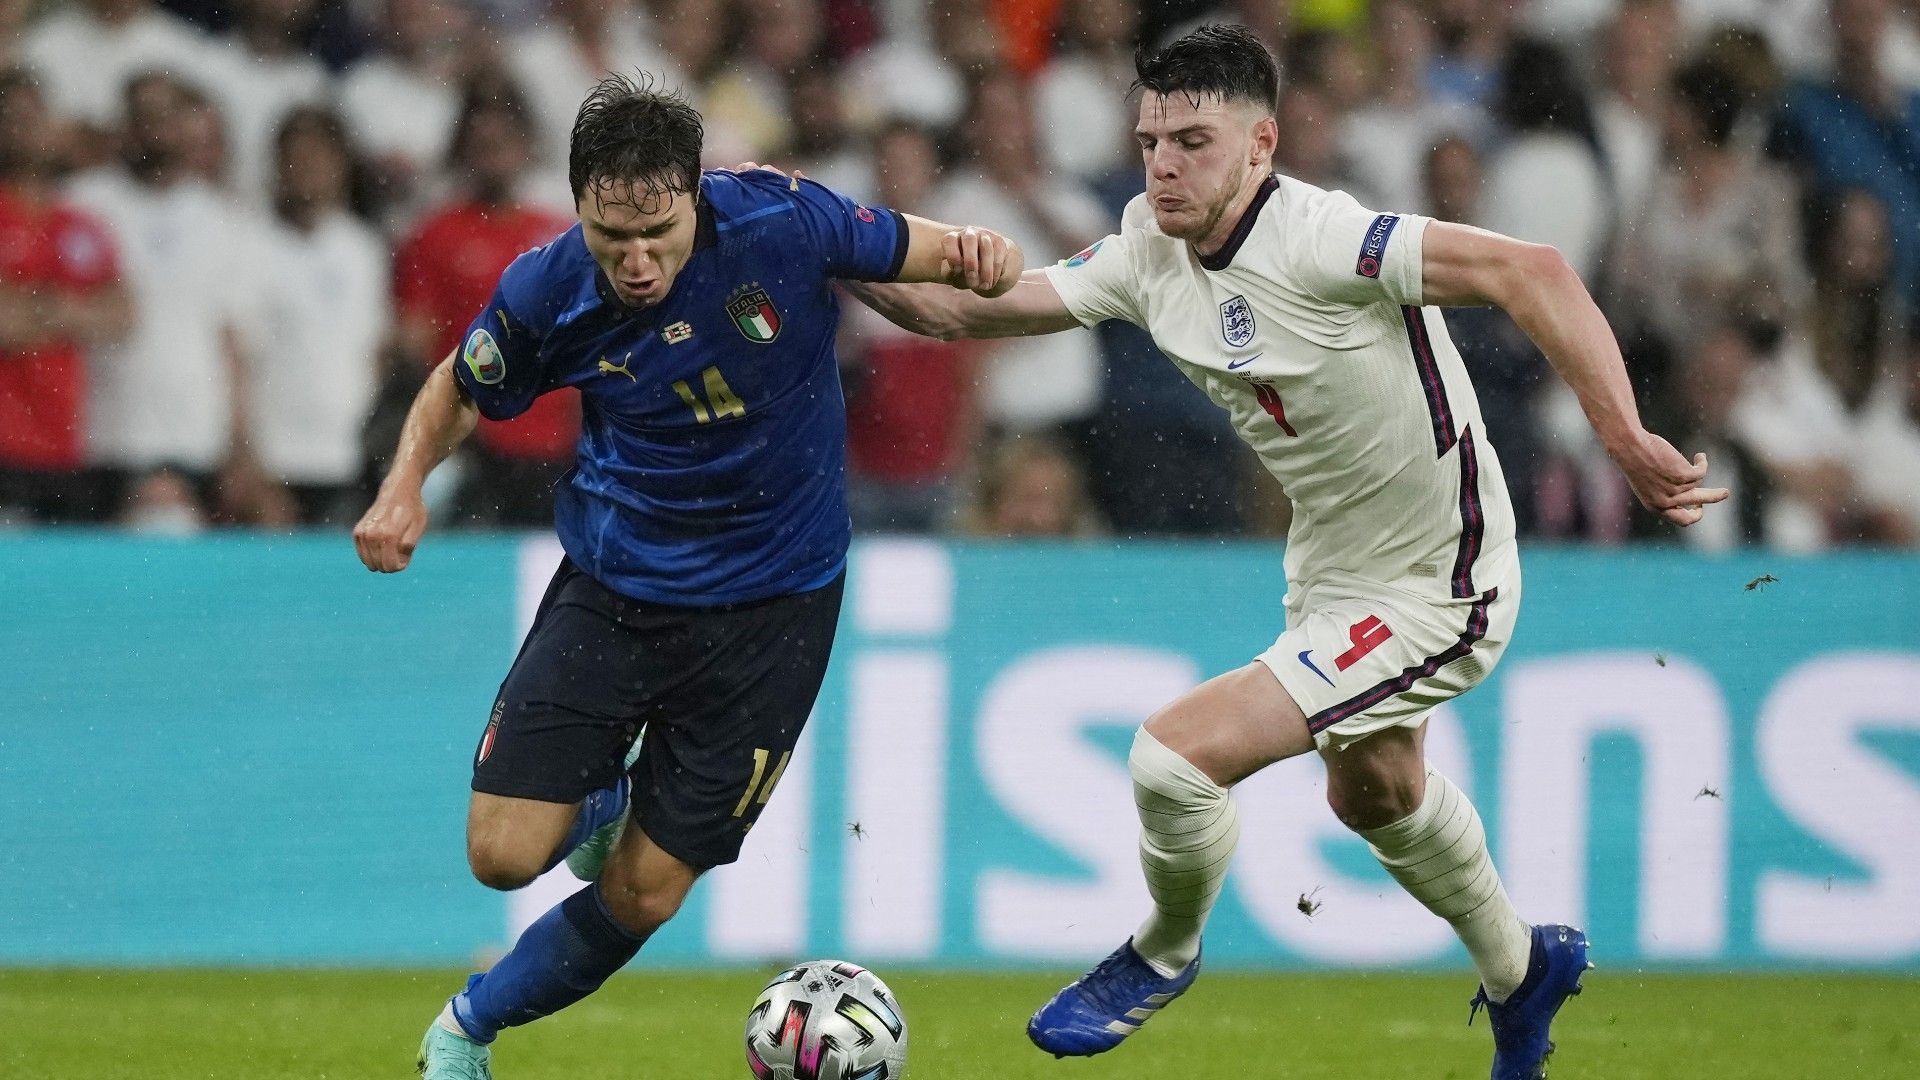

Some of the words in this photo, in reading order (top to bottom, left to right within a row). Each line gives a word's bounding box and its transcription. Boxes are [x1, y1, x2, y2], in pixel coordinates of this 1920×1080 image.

[1367, 215, 1393, 257] RESPECT
[731, 294, 764, 314] ITALIA
[671, 365, 746, 425] 14
[1250, 383, 1299, 438] 4
[1333, 614, 1393, 672] 4
